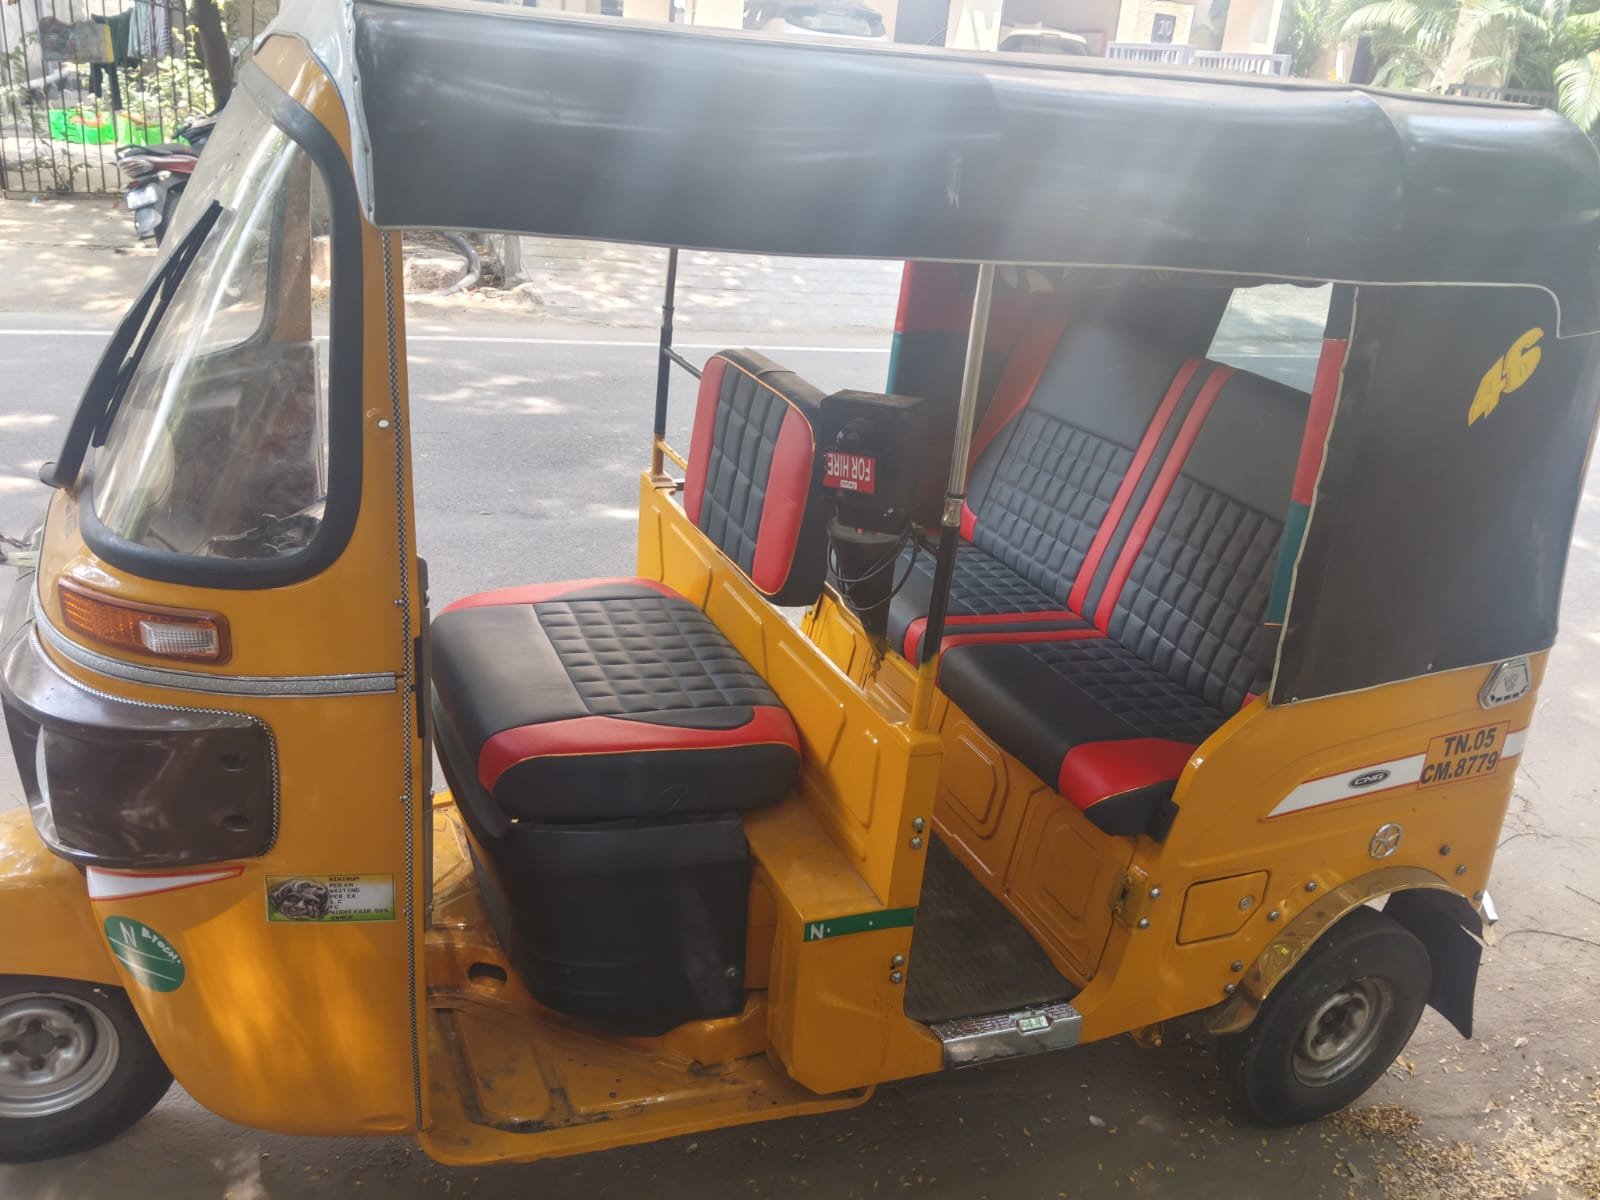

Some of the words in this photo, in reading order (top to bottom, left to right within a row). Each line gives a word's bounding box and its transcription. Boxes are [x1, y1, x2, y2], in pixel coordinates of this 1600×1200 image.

[827, 453, 849, 478] HIRE
[851, 456, 871, 482] FOR
[1444, 727, 1498, 757] TN.05
[1354, 771, 1386, 785] CNG
[1420, 751, 1499, 784] CM.8779
